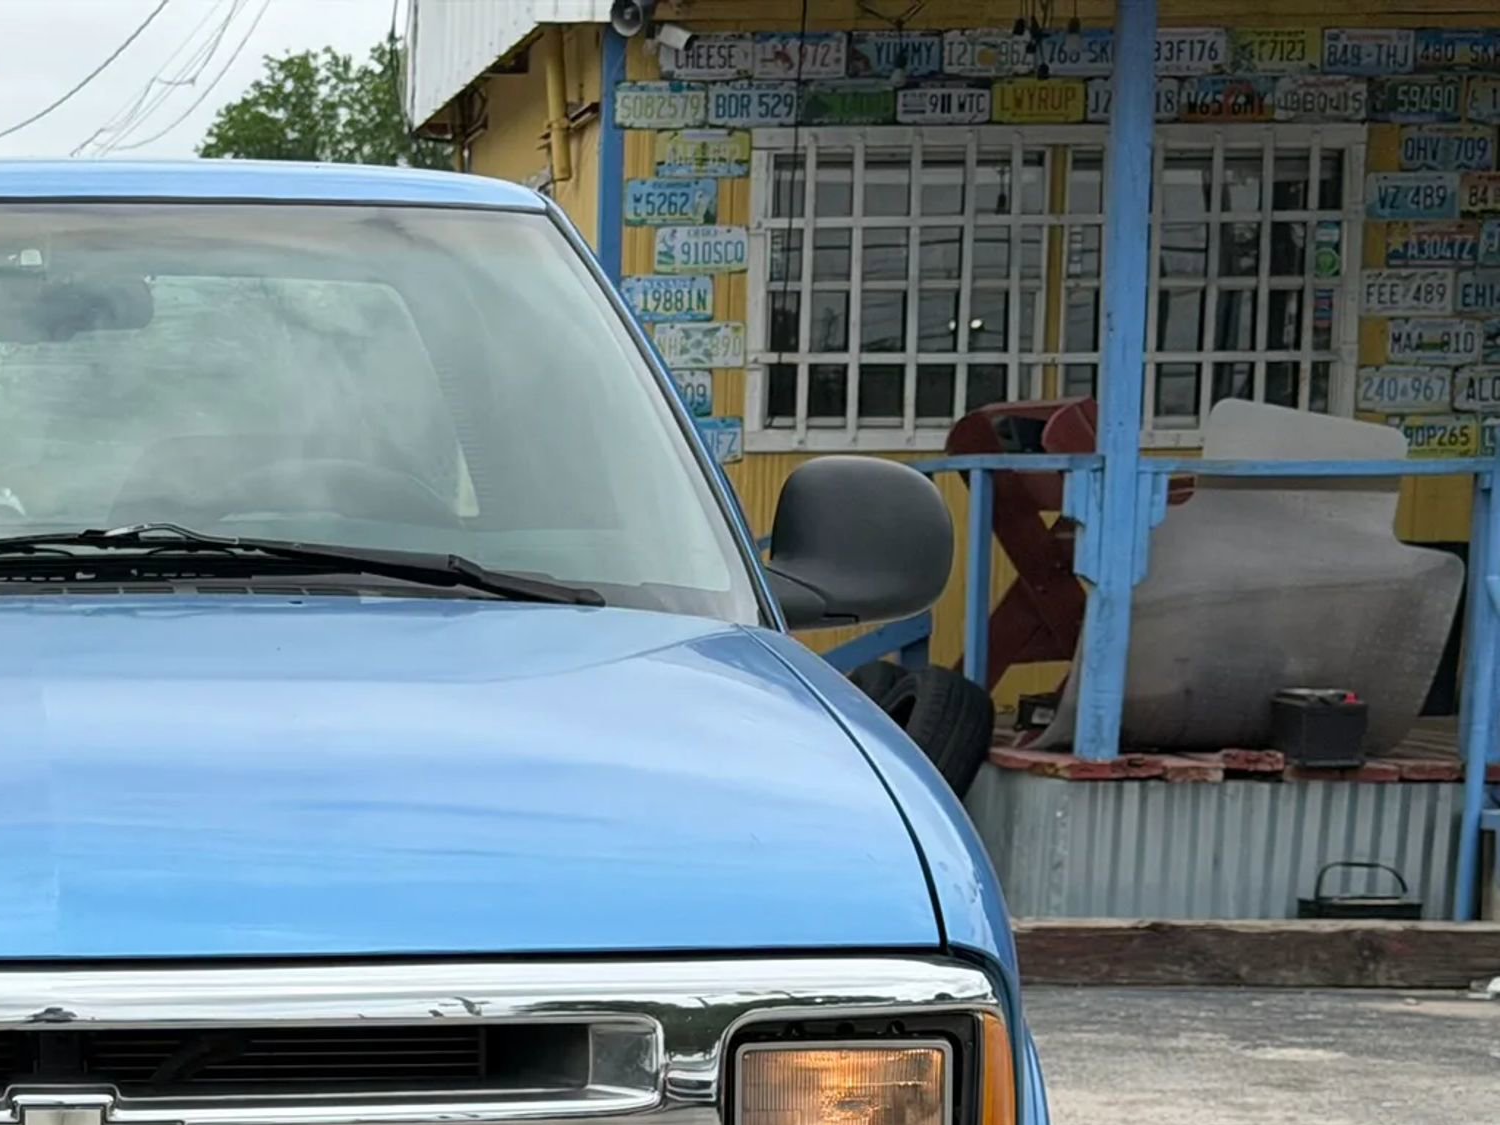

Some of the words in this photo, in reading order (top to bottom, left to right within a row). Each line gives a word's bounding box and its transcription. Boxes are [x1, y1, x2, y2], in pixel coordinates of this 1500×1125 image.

[674, 43, 737, 70] CHEESE
[757, 92, 794, 119] 529
[957, 92, 985, 114] WTC
[1000, 86, 1077, 112] LWYRUP
[1397, 86, 1456, 113] 59490
[1454, 136, 1488, 161] 709
[645, 192, 690, 217] 5262
[641, 288, 707, 313] 19881N
[1366, 283, 1400, 305] FEE
[1411, 283, 1447, 304] 489
[1362, 376, 1399, 401] 240
[1411, 376, 1446, 401] 967
